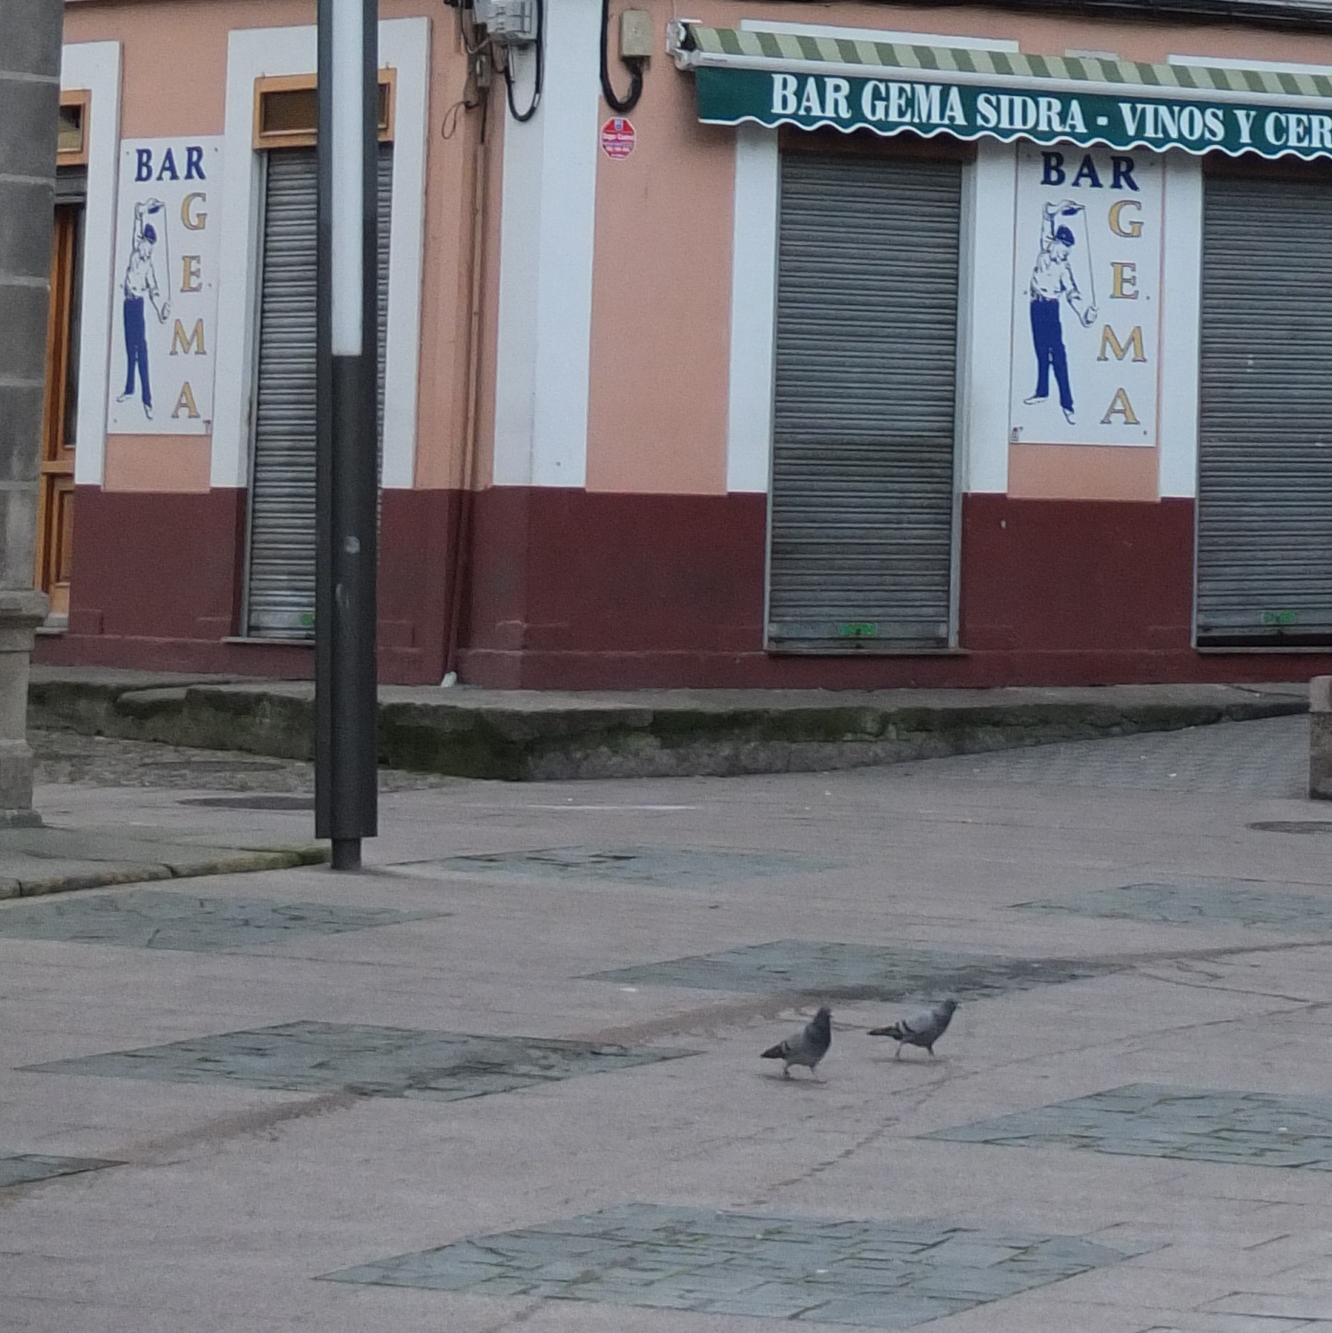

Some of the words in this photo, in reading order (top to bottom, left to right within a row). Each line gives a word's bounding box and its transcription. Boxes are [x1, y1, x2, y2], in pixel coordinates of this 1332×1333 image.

[770, 72, 852, 119] BAR
[861, 79, 969, 126] GEMA
[976, 92, 1089, 134] SIDRA
[1118, 102, 1225, 142] VINOS
[1232, 109, 1262, 145] Y
[133, 145, 207, 183] BAR
[1040, 150, 1141, 192] BAR
[169, 192, 208, 420] GEMA
[1096, 198, 1148, 426] GEMA
